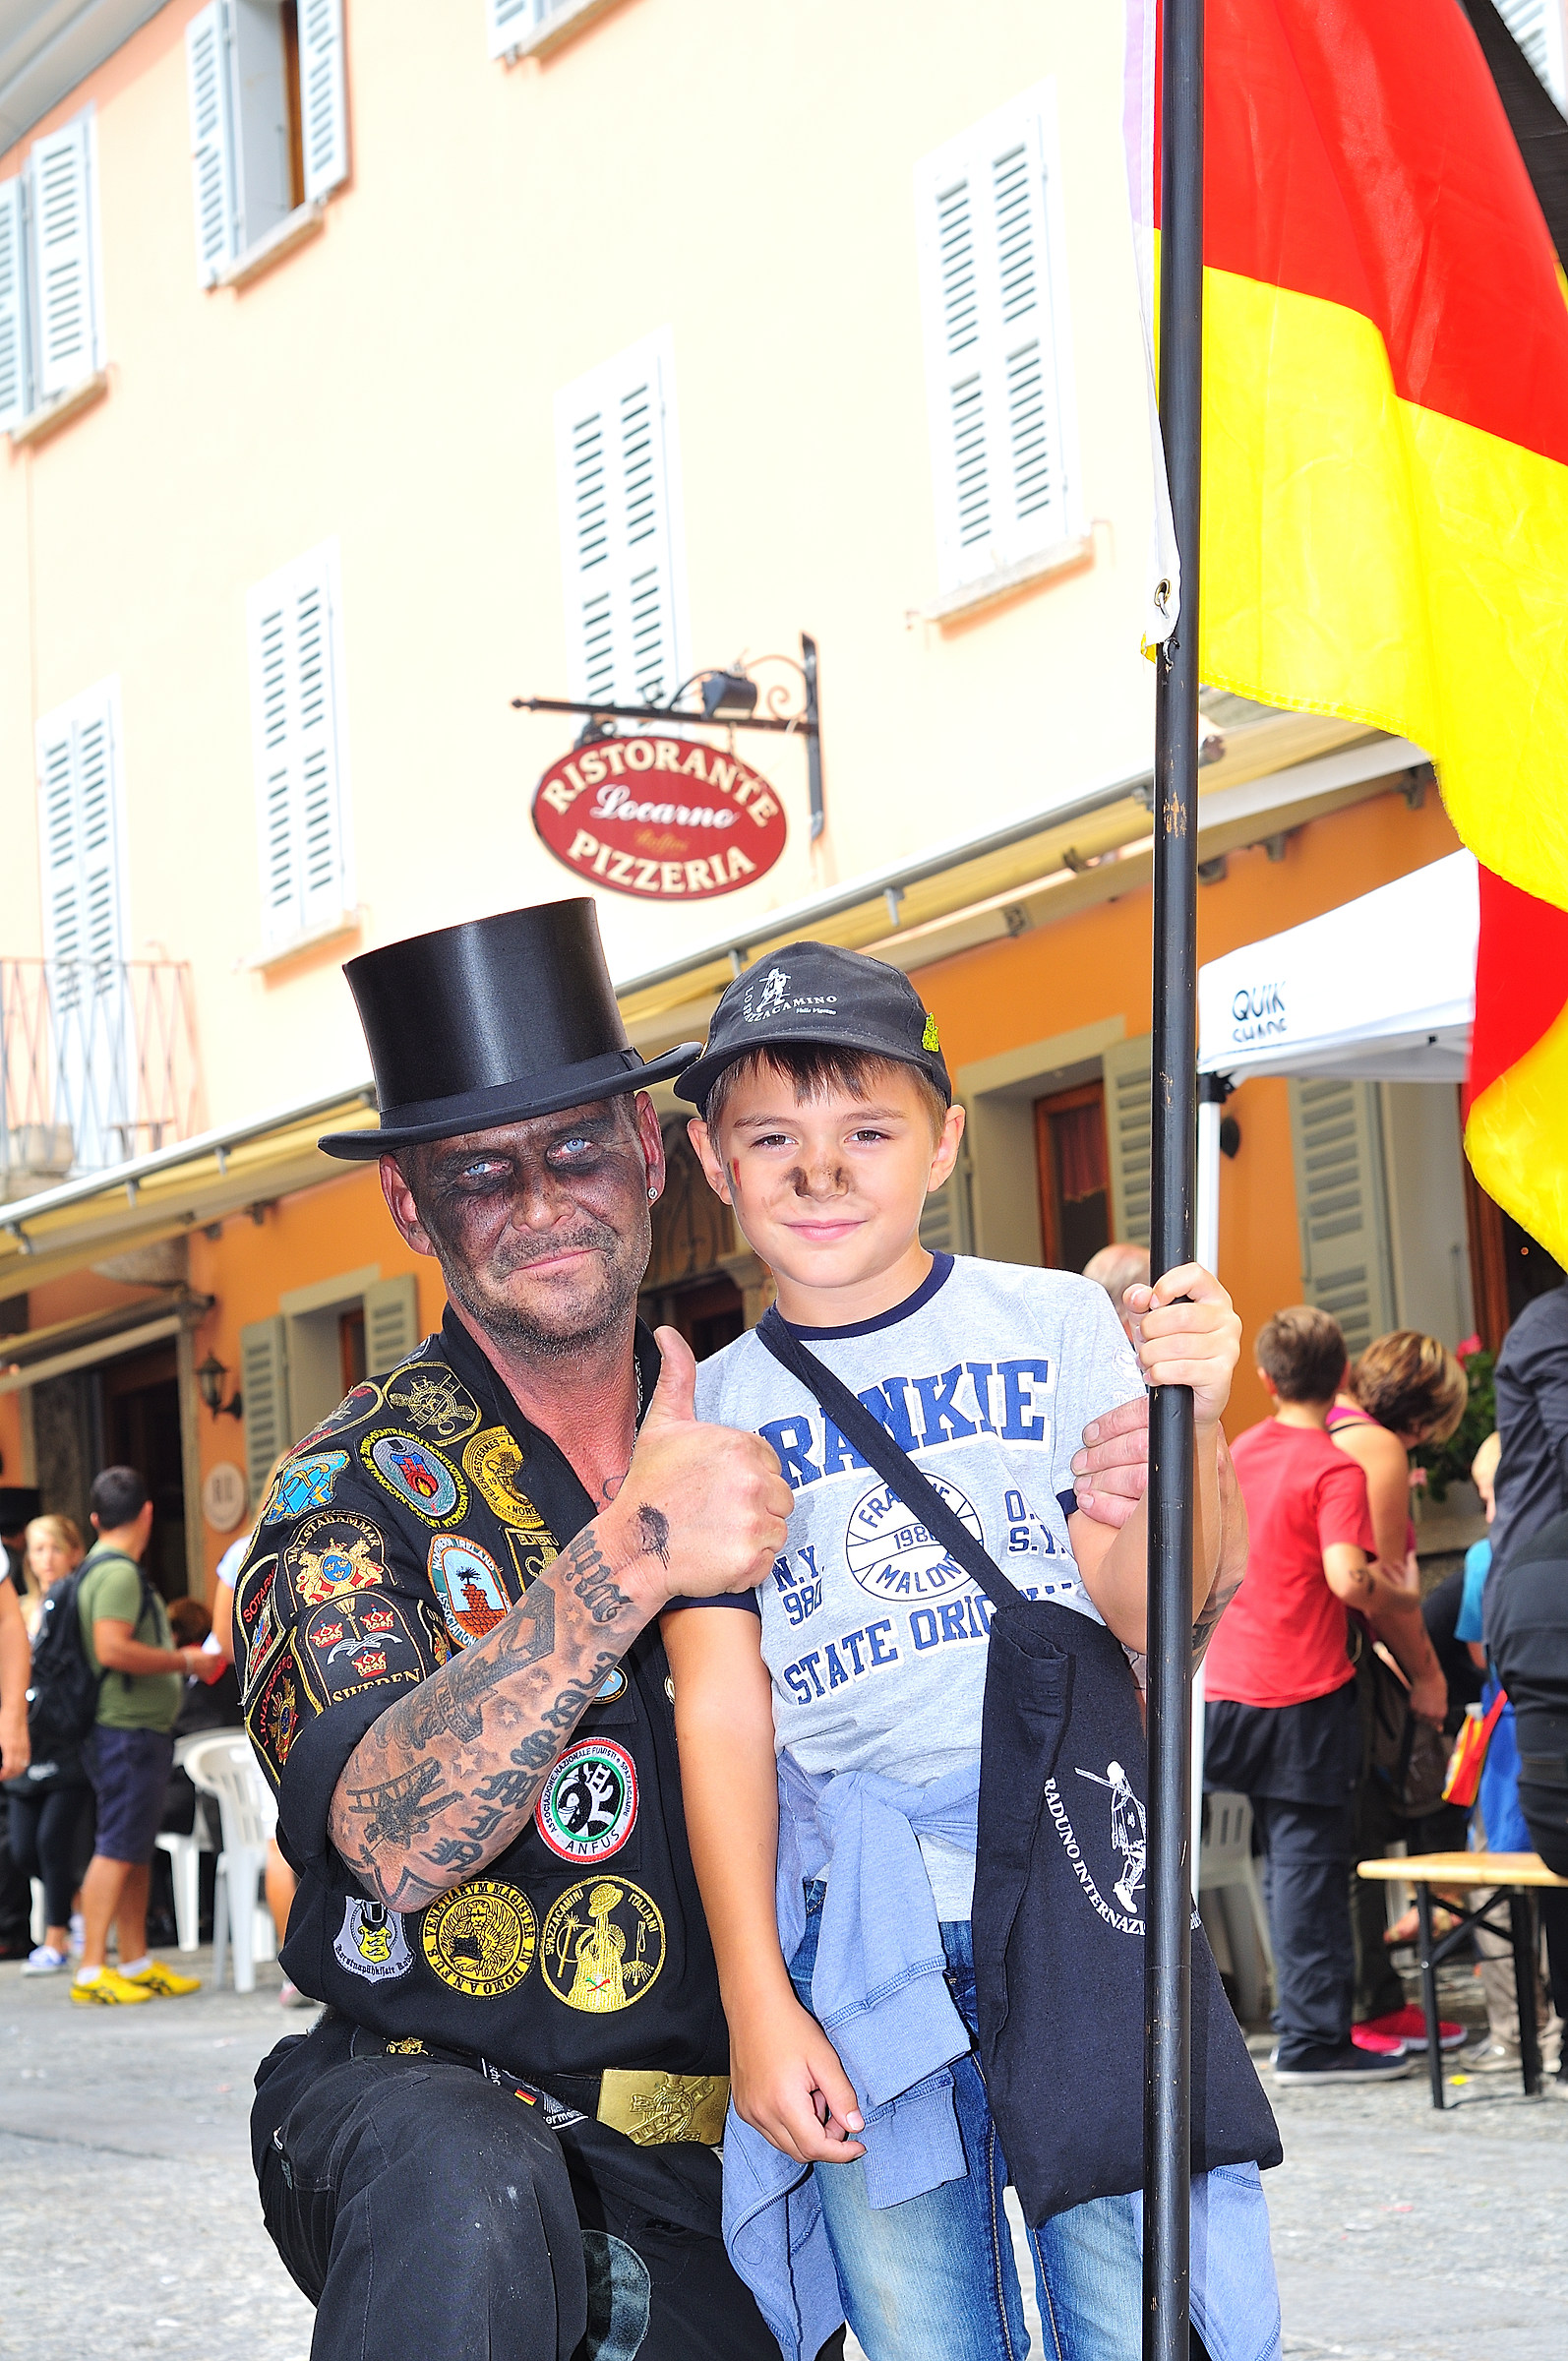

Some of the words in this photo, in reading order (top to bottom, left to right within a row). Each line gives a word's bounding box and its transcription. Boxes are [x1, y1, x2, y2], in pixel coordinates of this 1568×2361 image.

[542, 740, 780, 827] RISTORANTE
[589, 784, 742, 829] Locarno
[568, 829, 756, 893] PIZZERIA
[754, 1360, 1048, 1489] RANKIE
[455, 1538, 495, 1571] IRELAND
[437, 1592, 477, 1647] ASSOCIATION
[784, 1619, 899, 1706] STATE
[543, 1776, 558, 1833] ASSOCIAZIONE
[555, 1747, 591, 1778] NAZIONALE
[1044, 1777, 1081, 1859] RADUNO
[565, 1829, 620, 1854] ANFUS
[493, 1883, 535, 1939] MAGISTER
[545, 1888, 584, 1956] SPAZZACAMINI
[628, 1892, 660, 1933] ITALIANI
